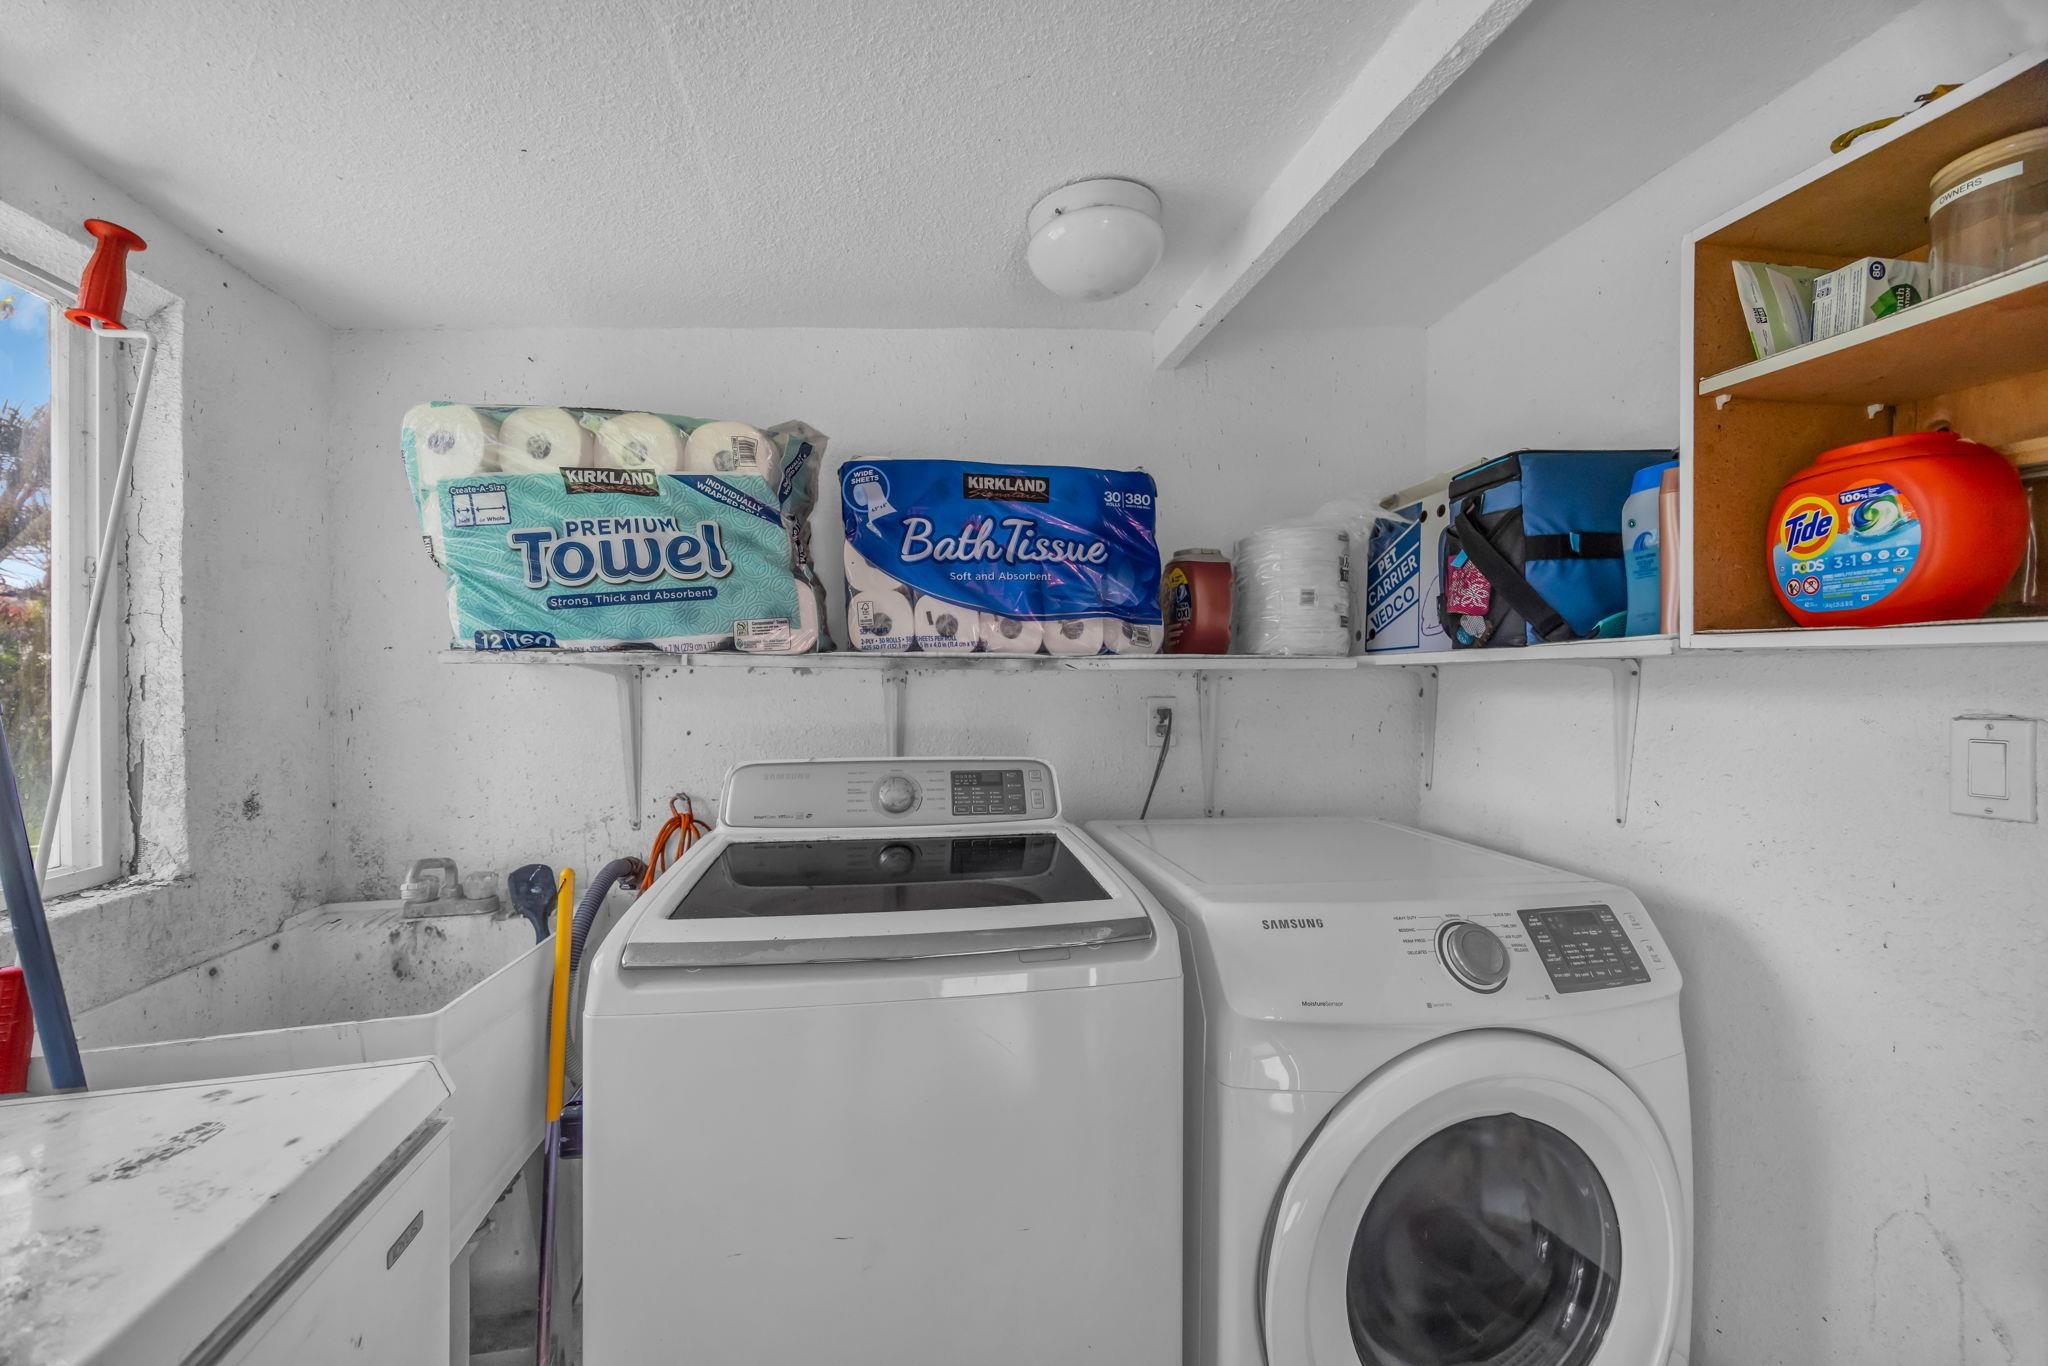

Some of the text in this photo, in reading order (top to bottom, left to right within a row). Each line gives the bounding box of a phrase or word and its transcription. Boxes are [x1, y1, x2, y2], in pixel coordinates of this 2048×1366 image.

[1940, 178, 1982, 205] OWNERS
[1872, 263, 1881, 278] 80
[565, 470, 654, 485] KIRKLAND
[851, 474, 879, 485] SHEETS
[853, 469, 873, 478] WIDE
[450, 484, 506, 495] Create-A-Size
[968, 476, 1046, 492] KIRKLAND
[705, 478, 763, 512] INDIVIDUALLY
[1104, 491, 1151, 506] 30 380
[1840, 492, 1868, 503] 100%
[565, 518, 680, 536] PREMIUM
[1785, 510, 1833, 552] Tide
[901, 517, 1109, 564] Bath Tissue
[512, 524, 727, 583] Towel
[1377, 546, 1397, 576] PET
[1792, 559, 1825, 575] PODS
[950, 572, 1052, 581] Soft and Absorbent
[1369, 555, 1418, 606] CARRIER
[550, 588, 713, 609] Strong, Thick and Absorbent
[1371, 586, 1415, 629] VEDCO
[481, 633, 503, 648] 12
[1262, 918, 1324, 930] SAMSUNG
